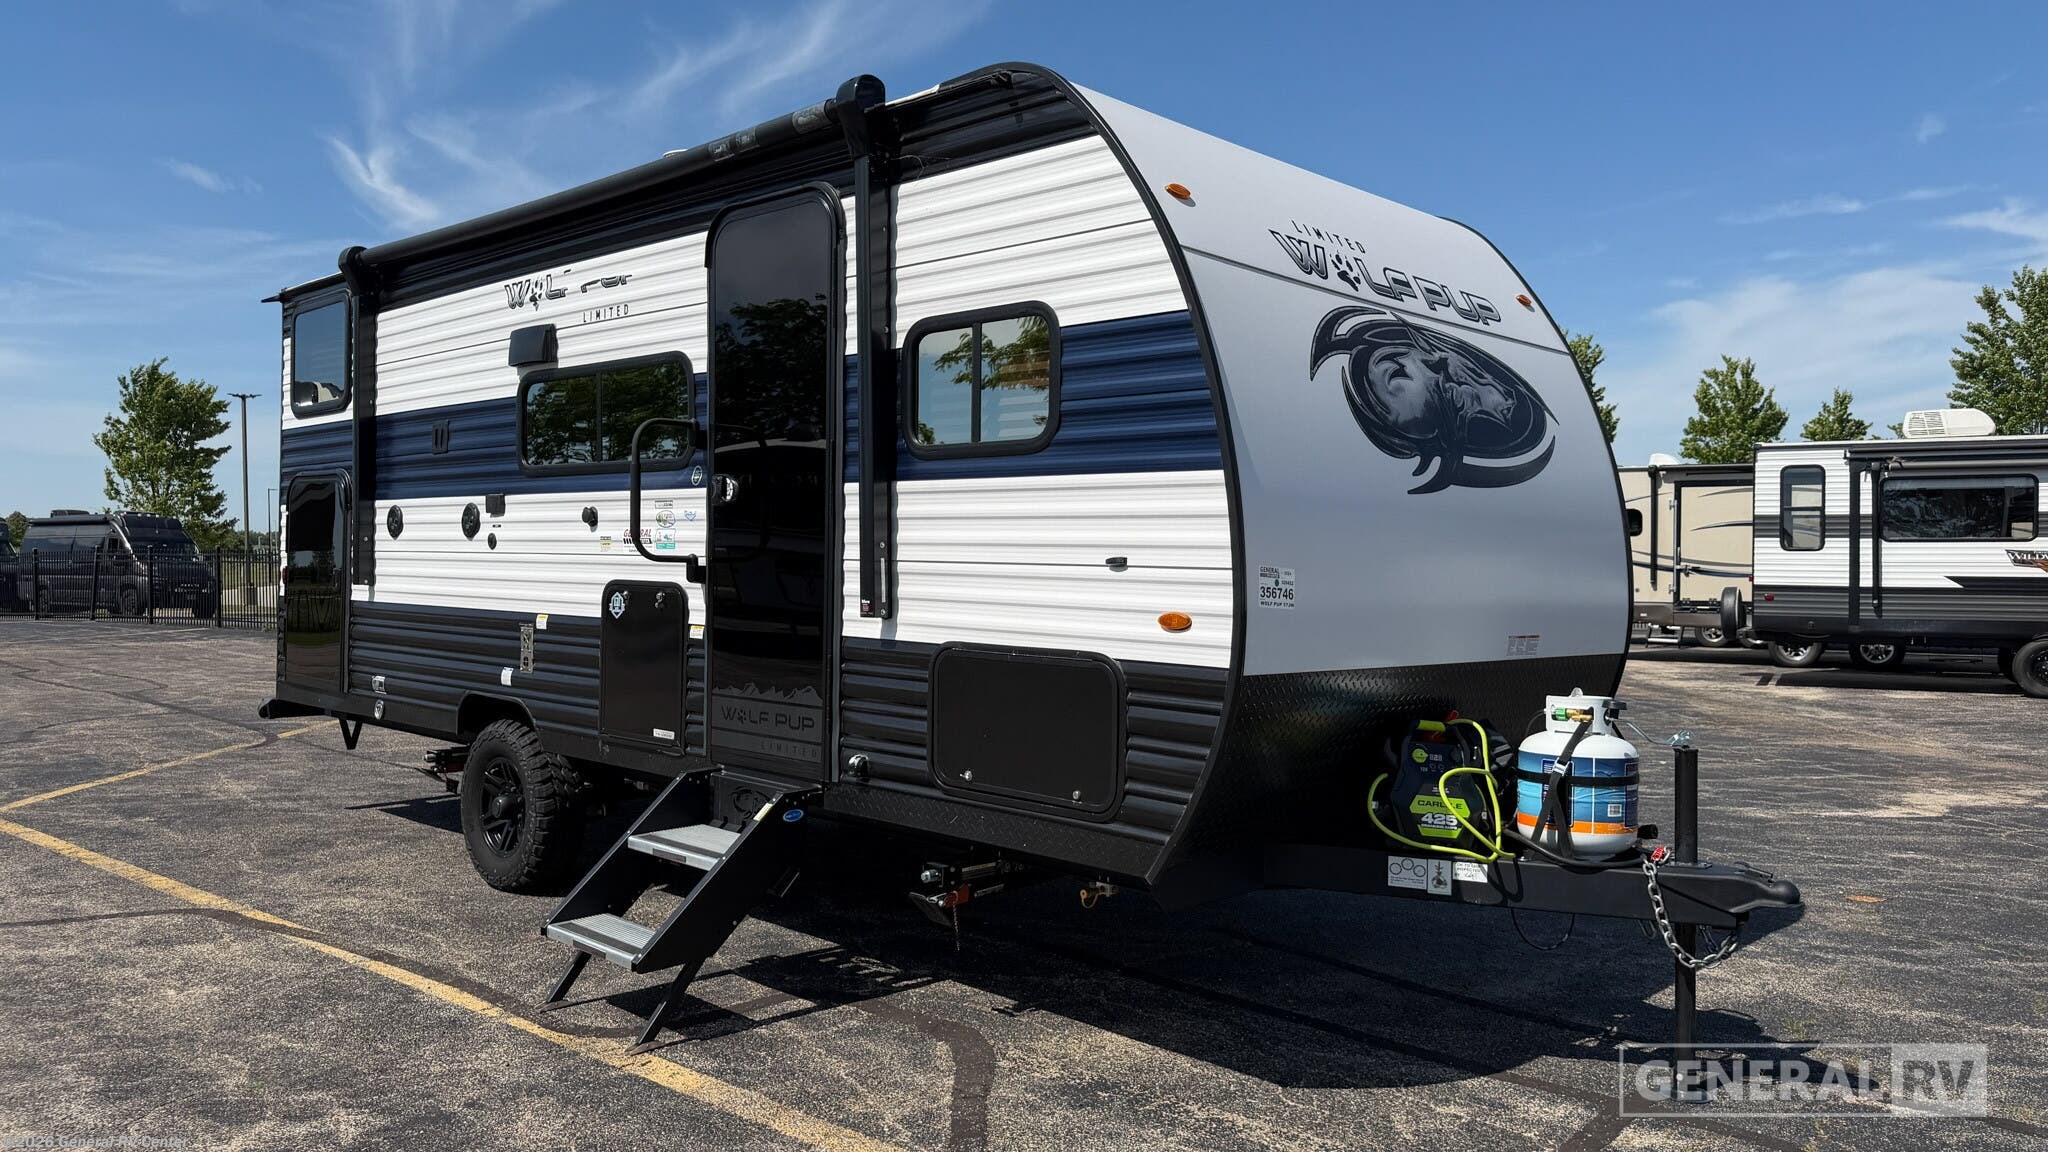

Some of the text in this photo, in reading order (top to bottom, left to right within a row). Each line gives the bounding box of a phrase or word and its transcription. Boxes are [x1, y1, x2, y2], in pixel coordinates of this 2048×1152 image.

[1291, 219, 1366, 254] LIMITED
[1412, 276, 1502, 326] PUP
[583, 303, 630, 323] LIMITED
[623, 528, 652, 538] GERAL
[1260, 586, 1294, 600] 356746
[775, 712, 815, 732] PUP
[1421, 812, 1458, 826] 425
